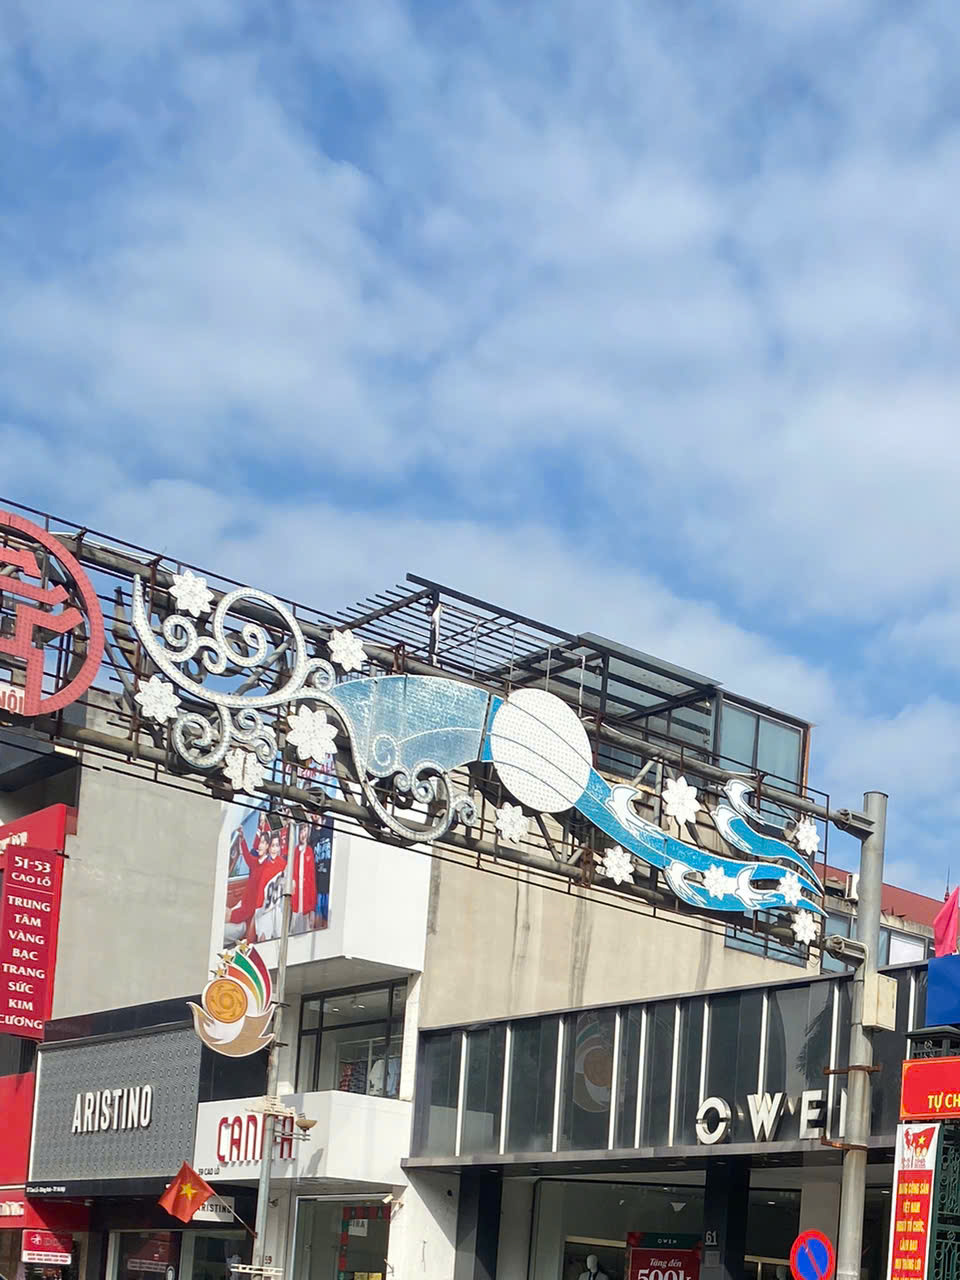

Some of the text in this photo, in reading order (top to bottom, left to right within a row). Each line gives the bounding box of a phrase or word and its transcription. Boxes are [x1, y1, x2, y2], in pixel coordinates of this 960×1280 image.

[14, 856, 51, 873] 51-53
[11, 872, 36, 884] CAO
[7, 895, 51, 912] TRUNG
[14, 913, 42, 928] TÂM
[8, 929, 45, 945] VÀNG
[12, 947, 39, 961] BẠC
[2, 962, 46, 979] TRANG
[8, 981, 34, 994] SỨC
[8, 999, 33, 1011] KIM
[72, 1084, 151, 1133] ARISTINO
[928, 1092, 943, 1112] TỰ
[198, 1203, 232, 1213] RISTINO
[705, 1230, 718, 1244] 61
